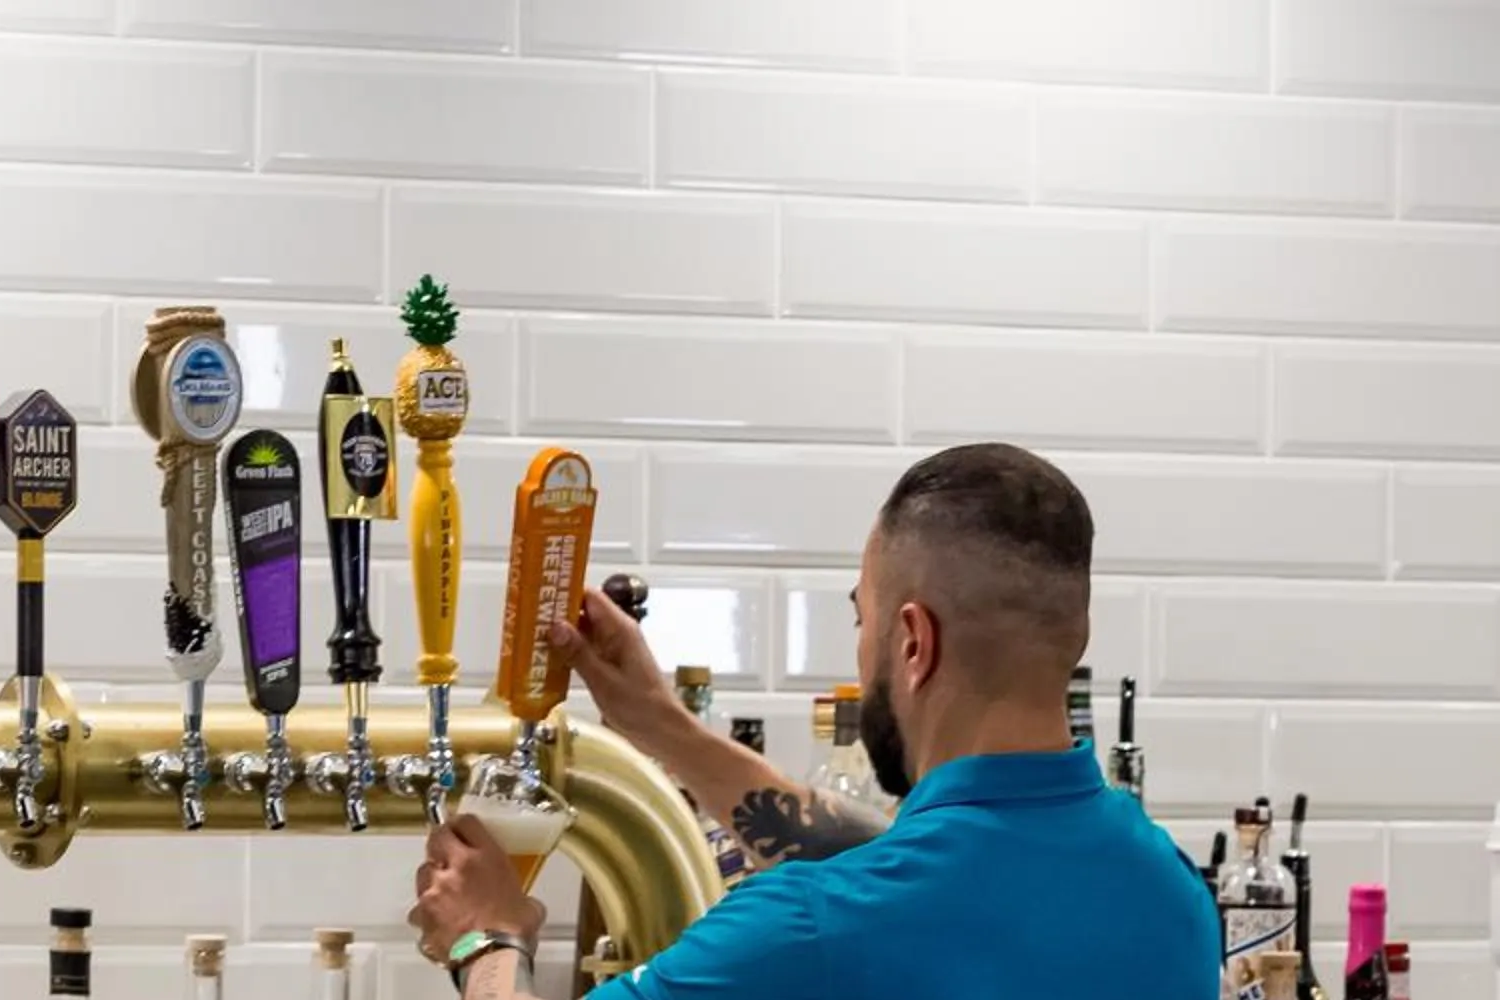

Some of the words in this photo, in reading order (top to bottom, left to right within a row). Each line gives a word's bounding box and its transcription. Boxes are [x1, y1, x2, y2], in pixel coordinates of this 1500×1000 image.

[423, 377, 464, 399] ACE
[13, 425, 71, 453] SAINT
[13, 456, 71, 477] ARCHER
[234, 464, 266, 479] Green
[192, 457, 208, 524] LEFT
[267, 500, 294, 533] IPA
[191, 530, 208, 618] COAST
[527, 535, 563, 699] HEFEWEIZEN
